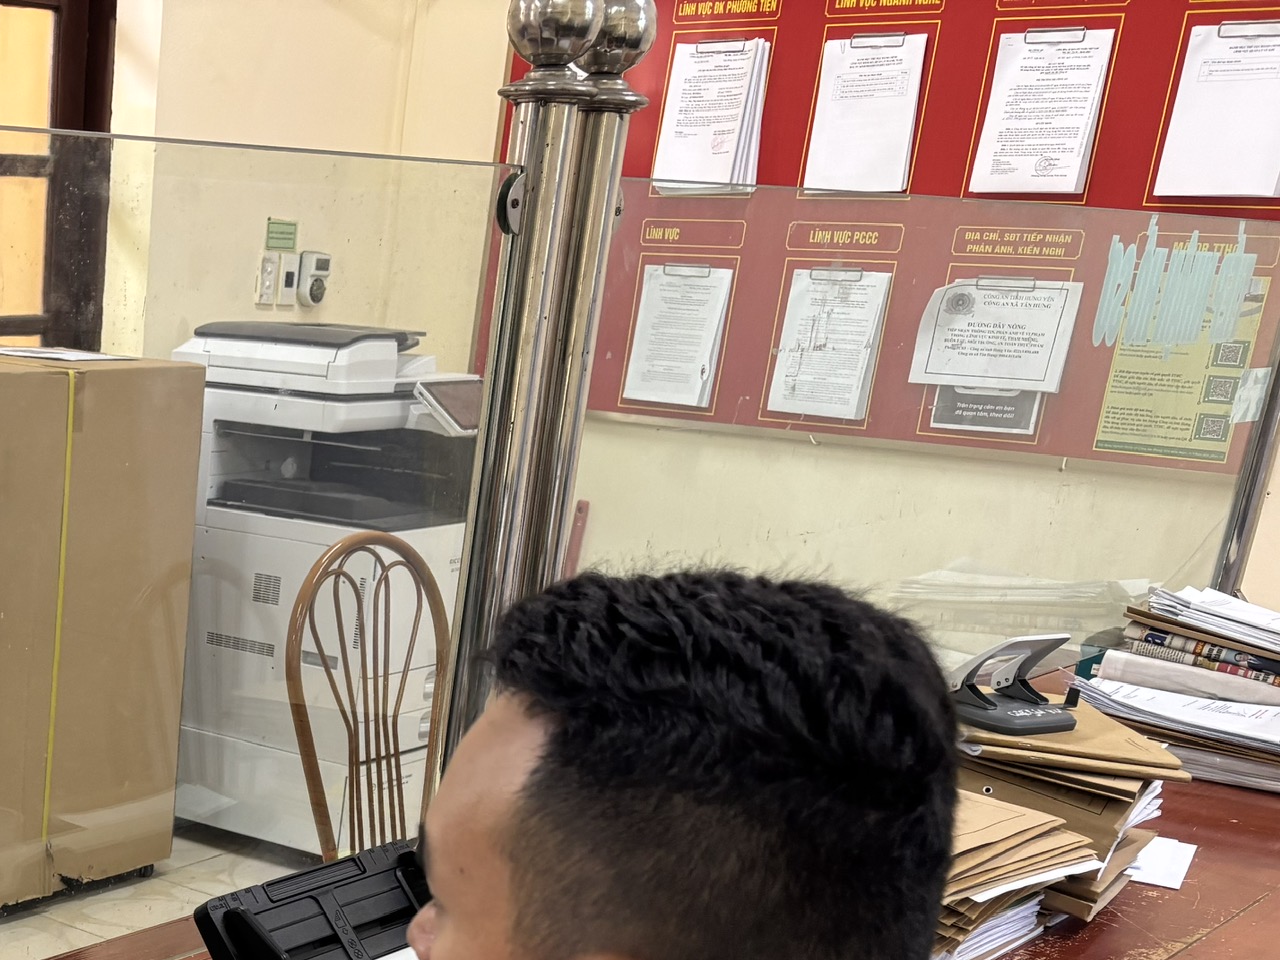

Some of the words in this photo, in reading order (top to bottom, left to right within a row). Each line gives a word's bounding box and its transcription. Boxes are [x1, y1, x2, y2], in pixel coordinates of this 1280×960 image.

[664, 227, 680, 242] VỰC
[809, 228, 831, 243] LĨNH
[832, 230, 852, 246] VỰC
[853, 231, 879, 244] PCCC
[1045, 234, 1072, 244] NHẬN
[1042, 247, 1066, 257] NGHỊ
